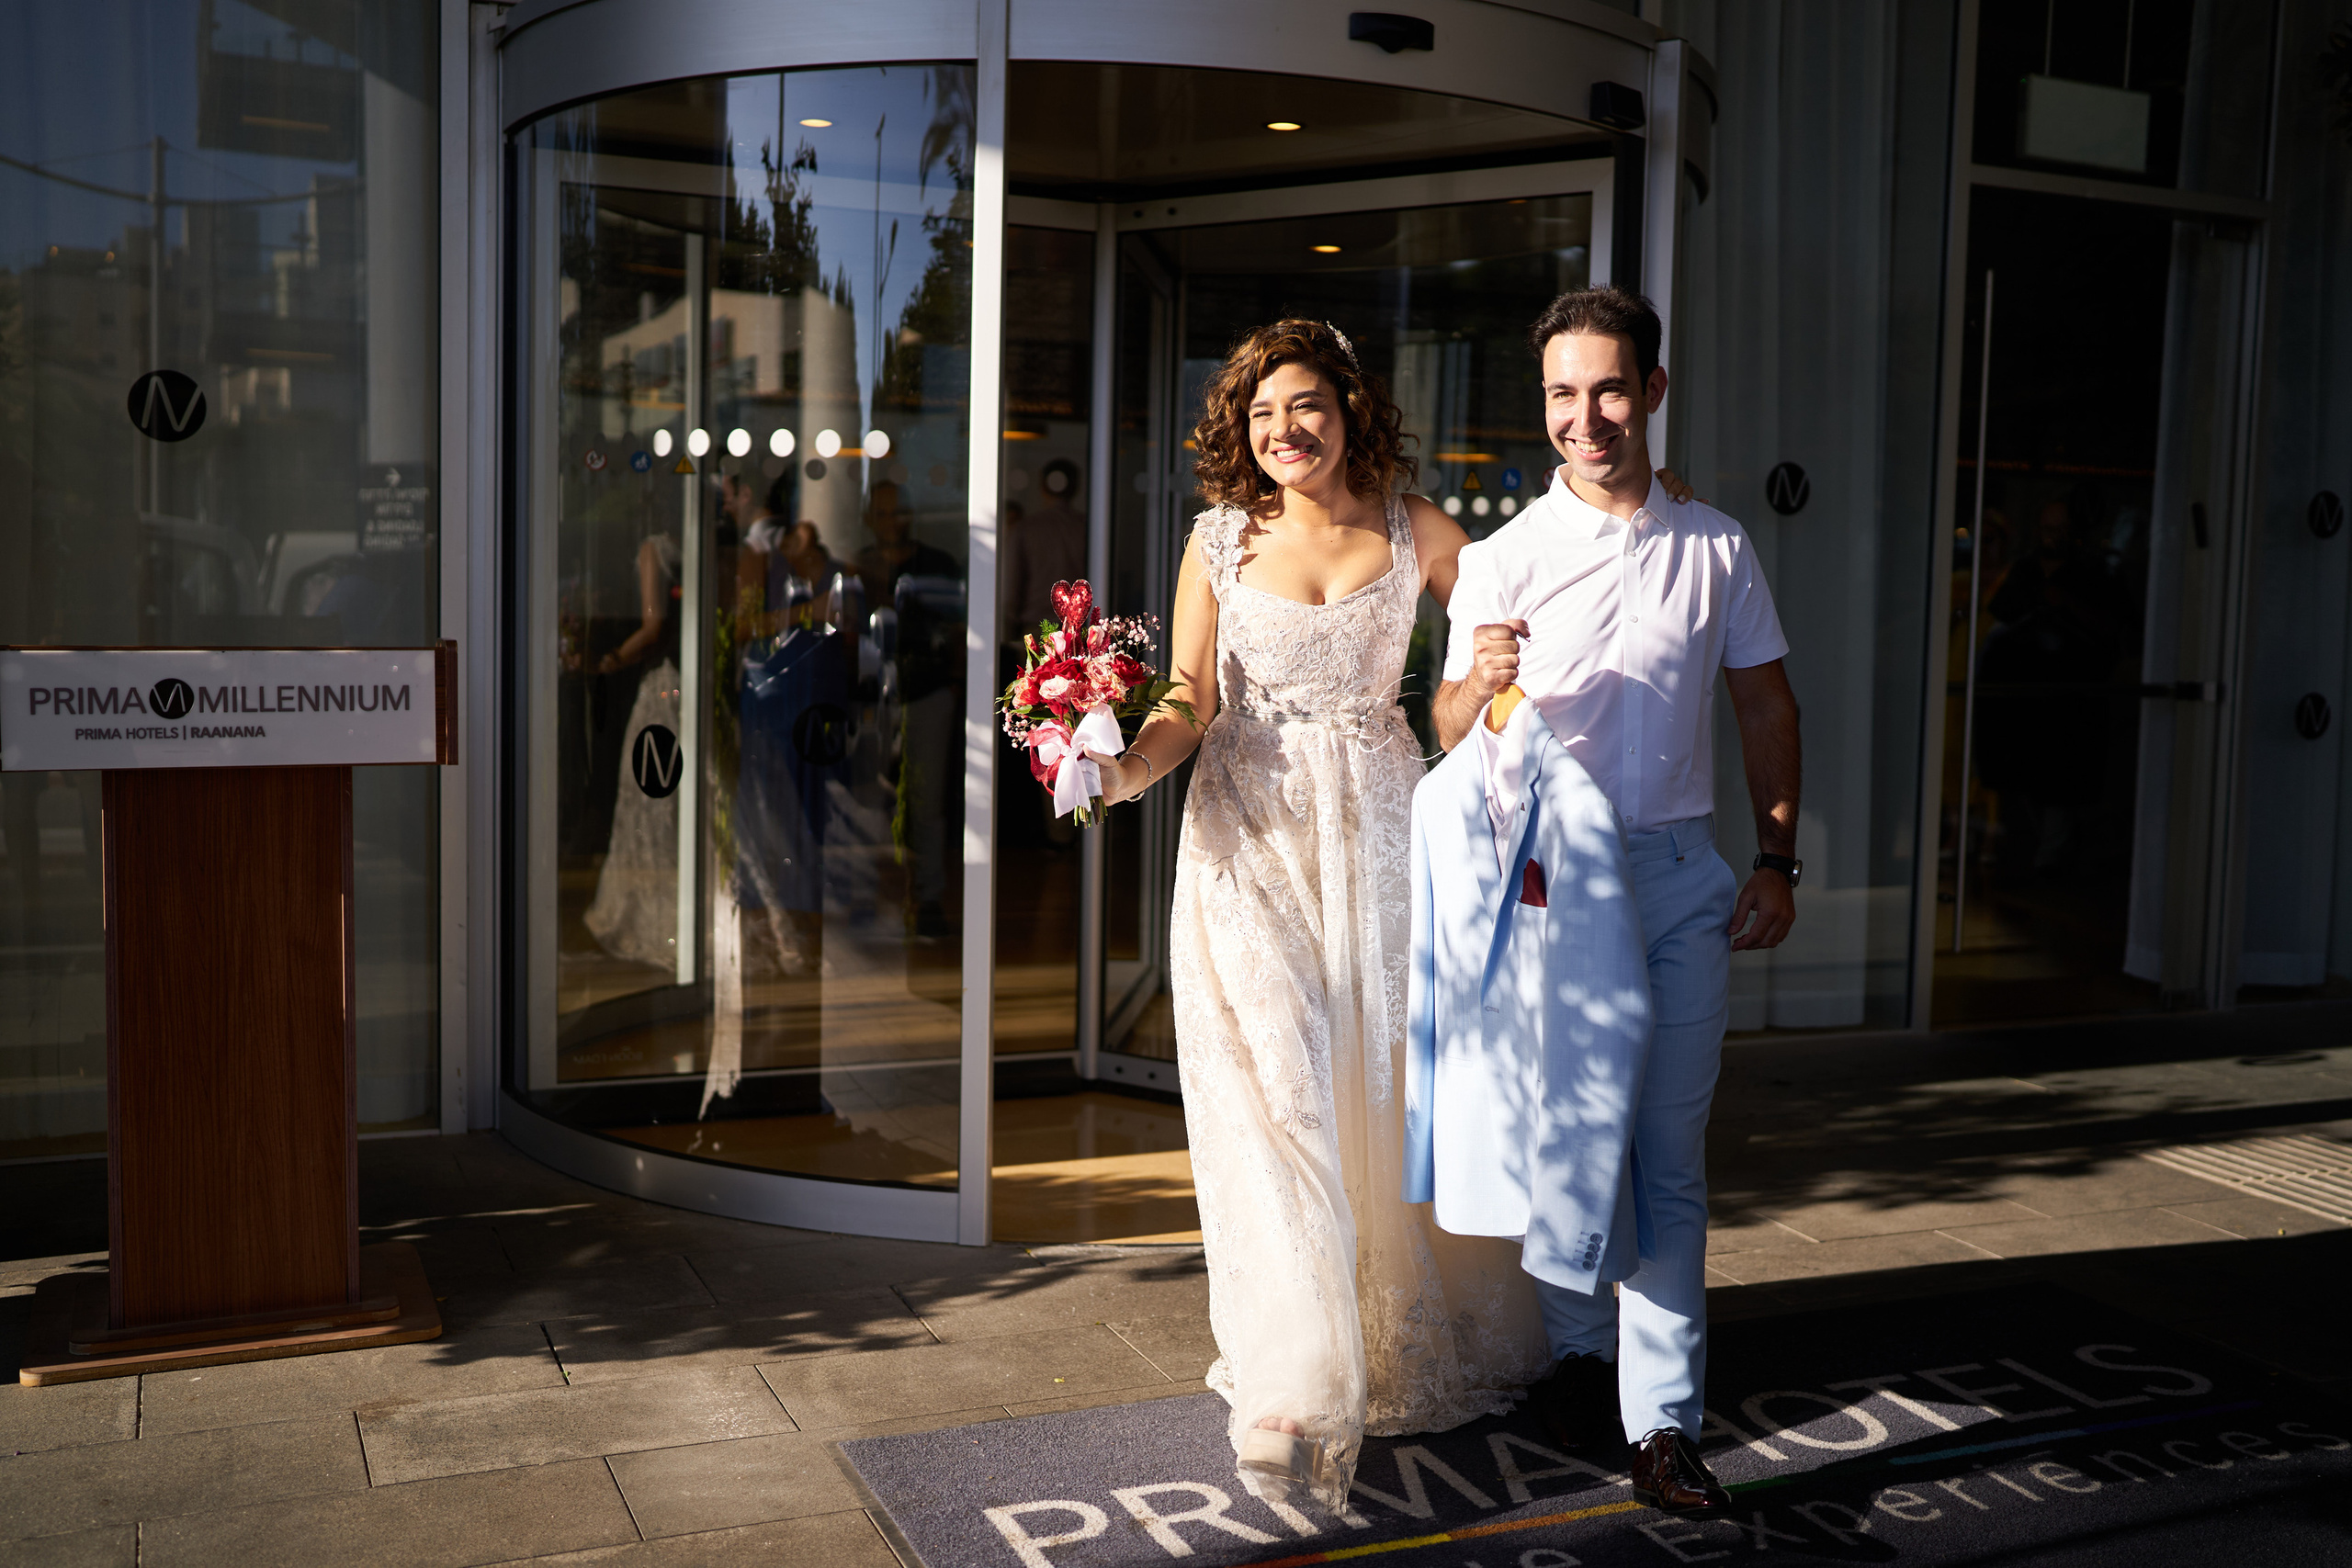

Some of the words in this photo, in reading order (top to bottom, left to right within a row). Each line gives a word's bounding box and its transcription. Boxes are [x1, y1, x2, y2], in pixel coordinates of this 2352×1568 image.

[29, 687, 147, 716] PRIMA
[198, 685, 411, 713] MILLENNIUM
[75, 728, 122, 740] PRIMA
[126, 727, 179, 739] HOTELS
[190, 726, 266, 739] RAANANA
